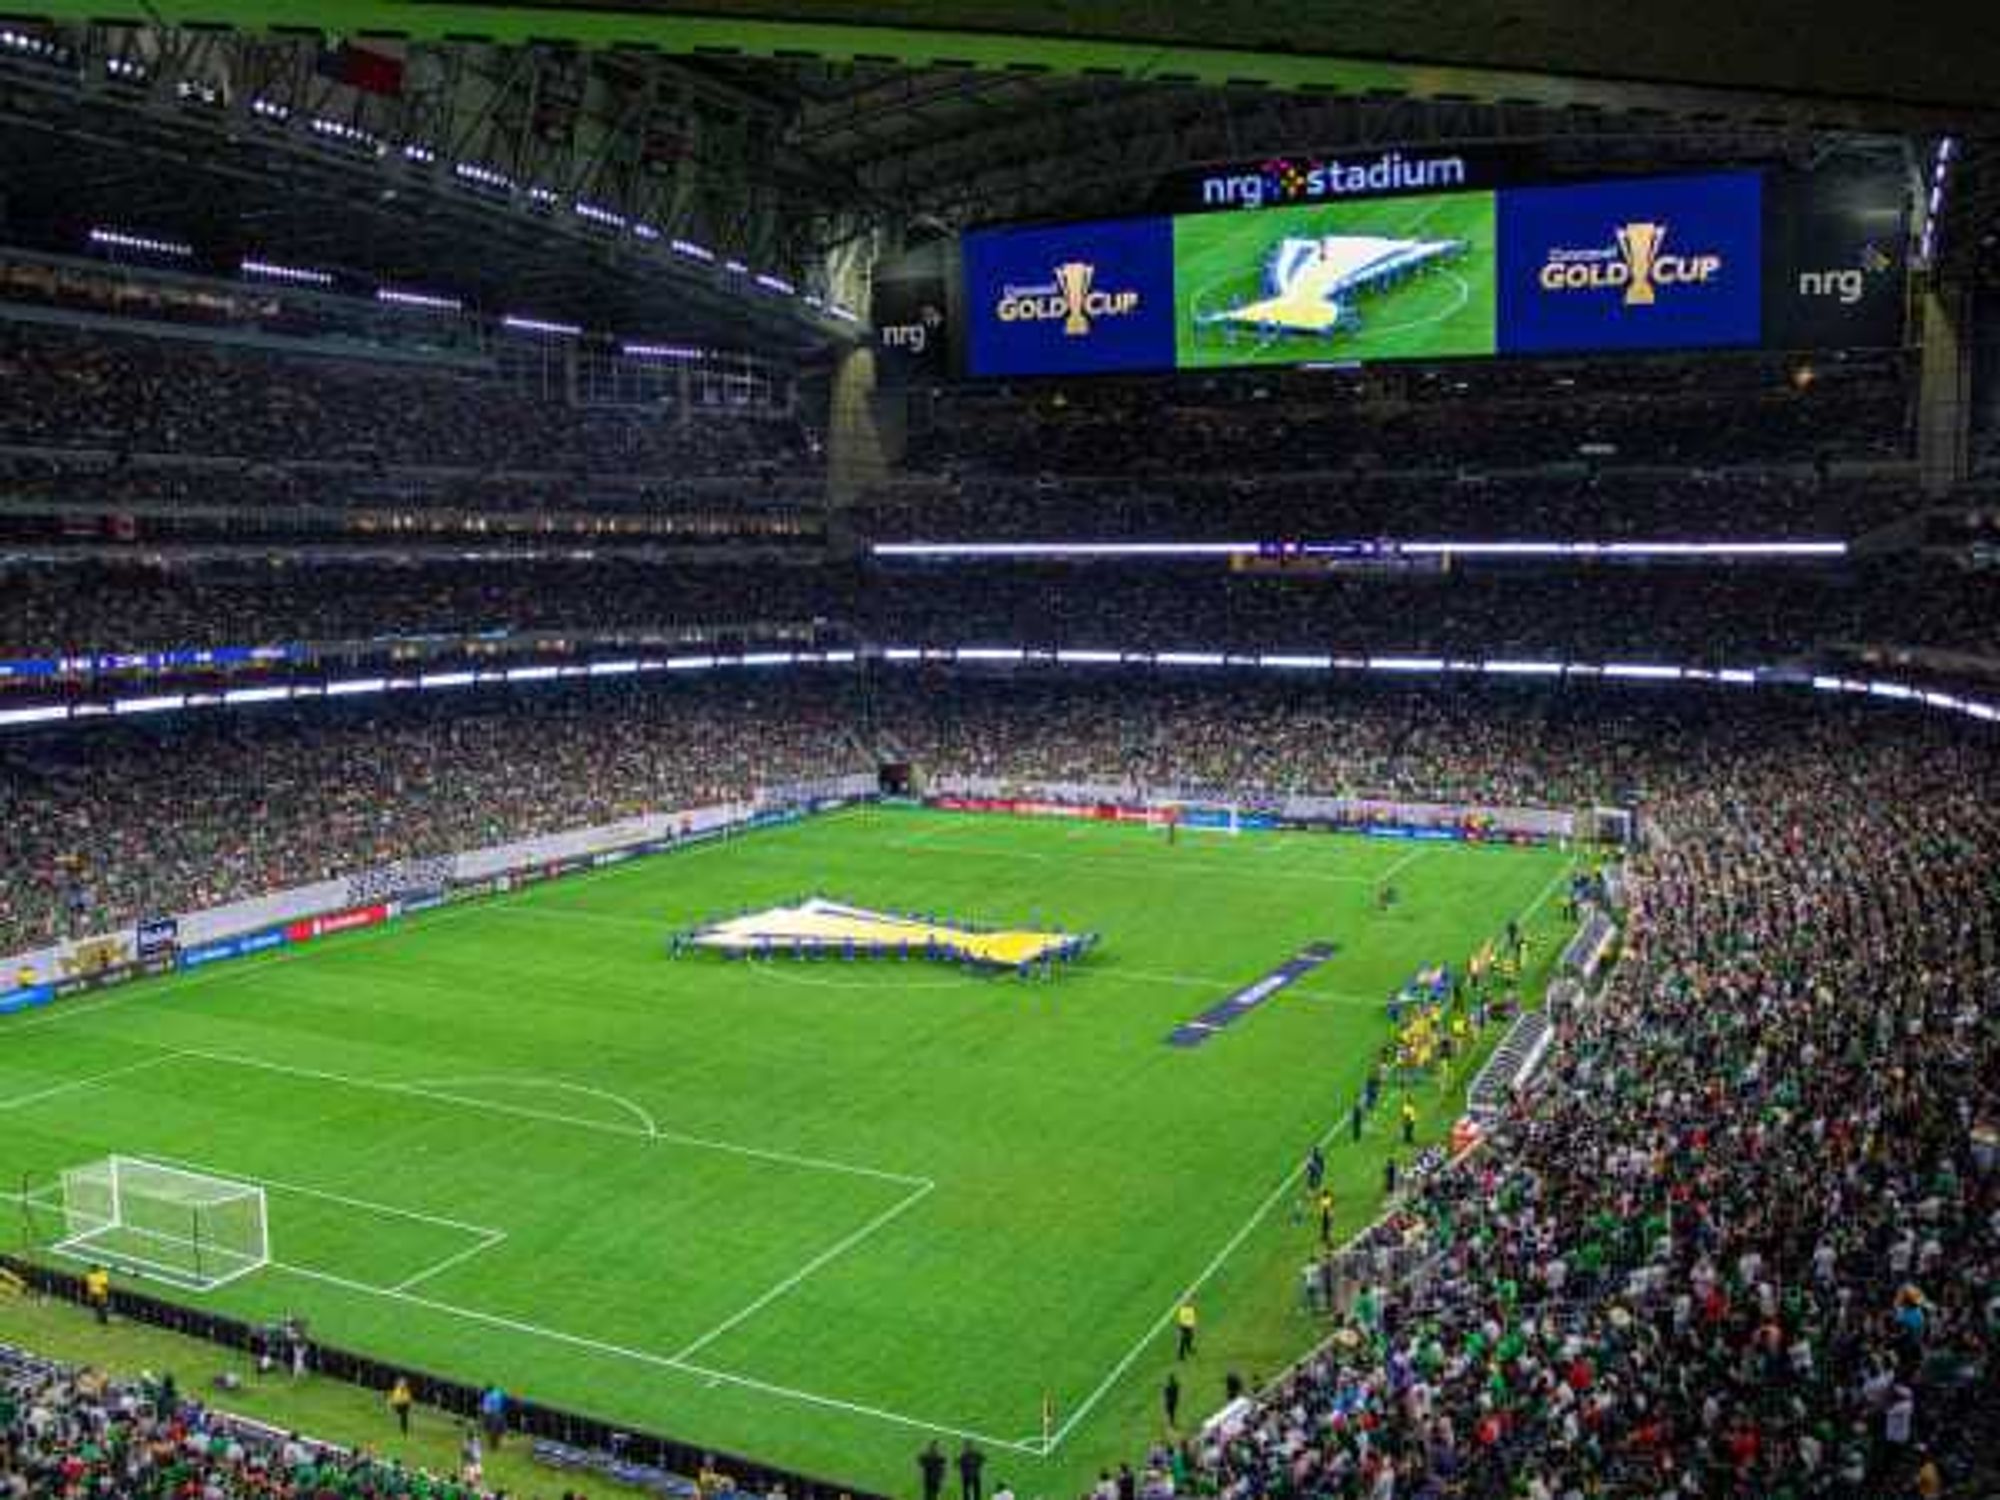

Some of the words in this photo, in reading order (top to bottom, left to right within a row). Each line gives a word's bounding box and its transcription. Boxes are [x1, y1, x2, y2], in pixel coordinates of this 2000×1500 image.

[1203, 174, 1262, 208] nrg
[1306, 152, 1465, 195] stadium
[1541, 261, 1629, 289] GOLD
[1653, 255, 1721, 284] CUP
[1799, 269, 1862, 304] nrg
[998, 297, 1067, 321] GOLD
[1087, 292, 1138, 316] CUP
[882, 324, 925, 352] nrg
